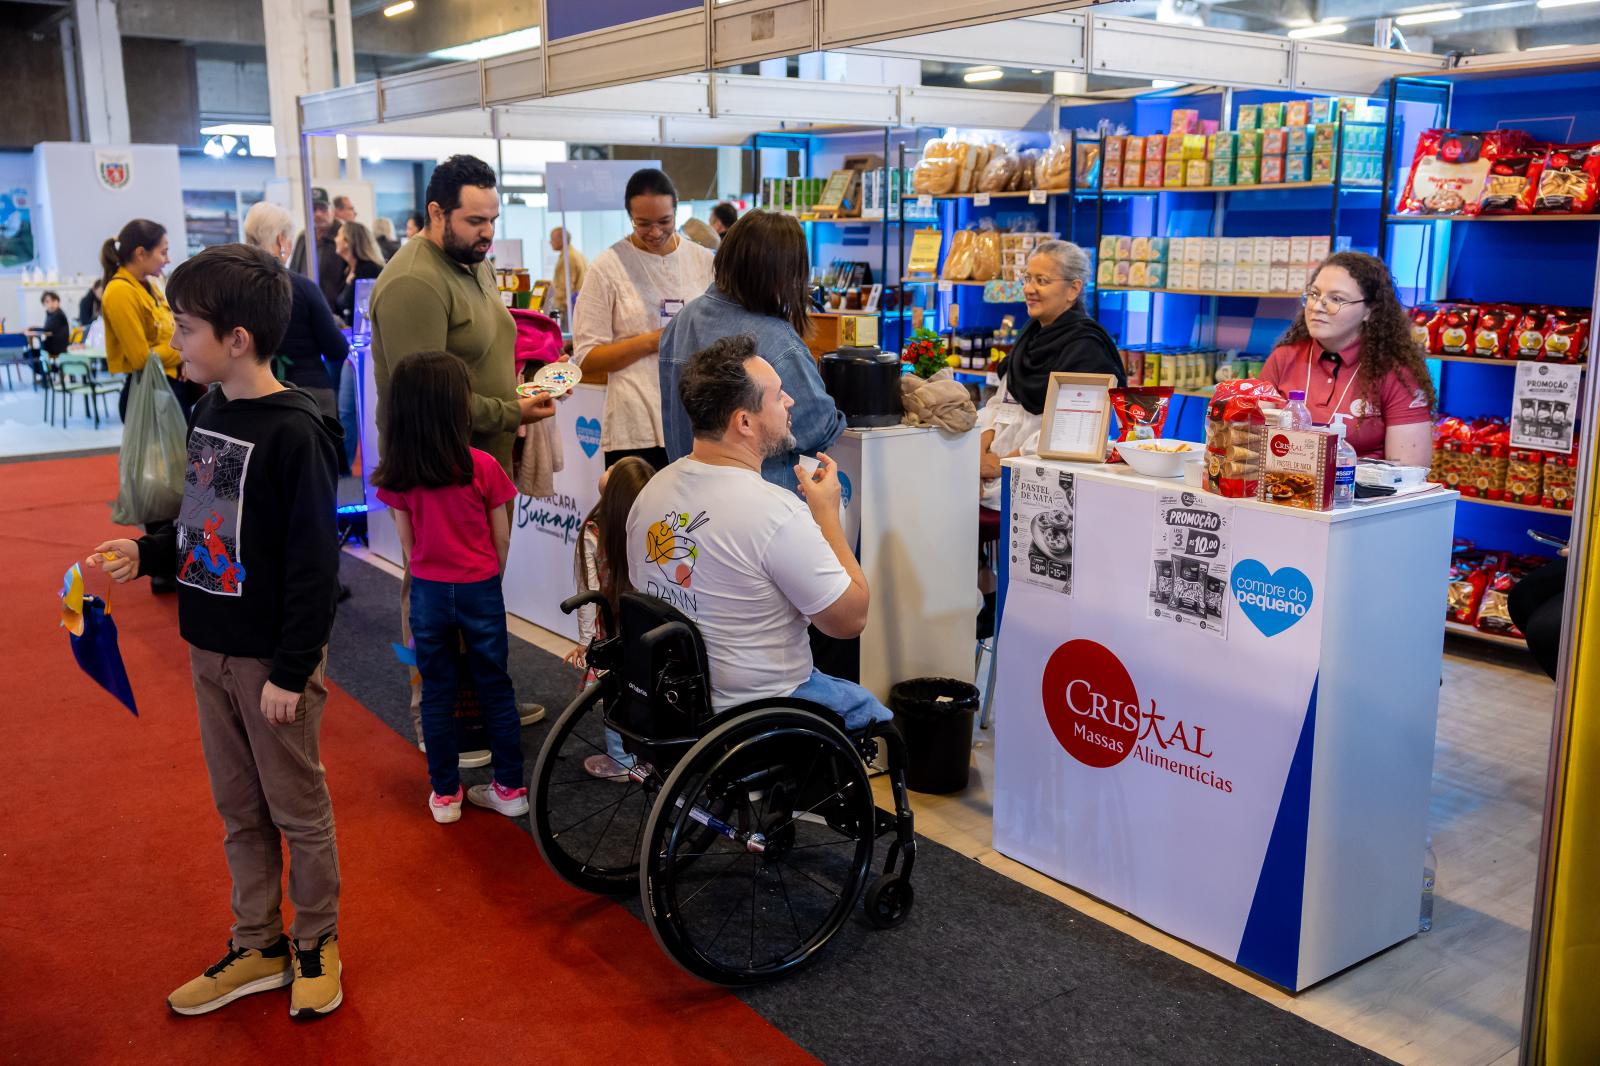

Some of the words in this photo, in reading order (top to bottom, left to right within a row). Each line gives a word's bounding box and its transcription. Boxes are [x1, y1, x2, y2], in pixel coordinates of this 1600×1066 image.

[1526, 380, 1569, 389] PROMOÇÃO
[1021, 482, 1050, 495] PASTEL
[1021, 491, 1031, 500] DE
[1033, 493, 1054, 504] NATA
[1169, 510, 1218, 529] PROMOÇÃO
[1174, 533, 1184, 547] 3
[1236, 577, 1286, 598] compre
[1288, 586, 1307, 603] do
[1236, 590, 1307, 617] pequeno
[1065, 679, 1213, 759] CRISTAL
[1073, 721, 1124, 754] Massas
[1133, 744, 1233, 793] Alimentícias
